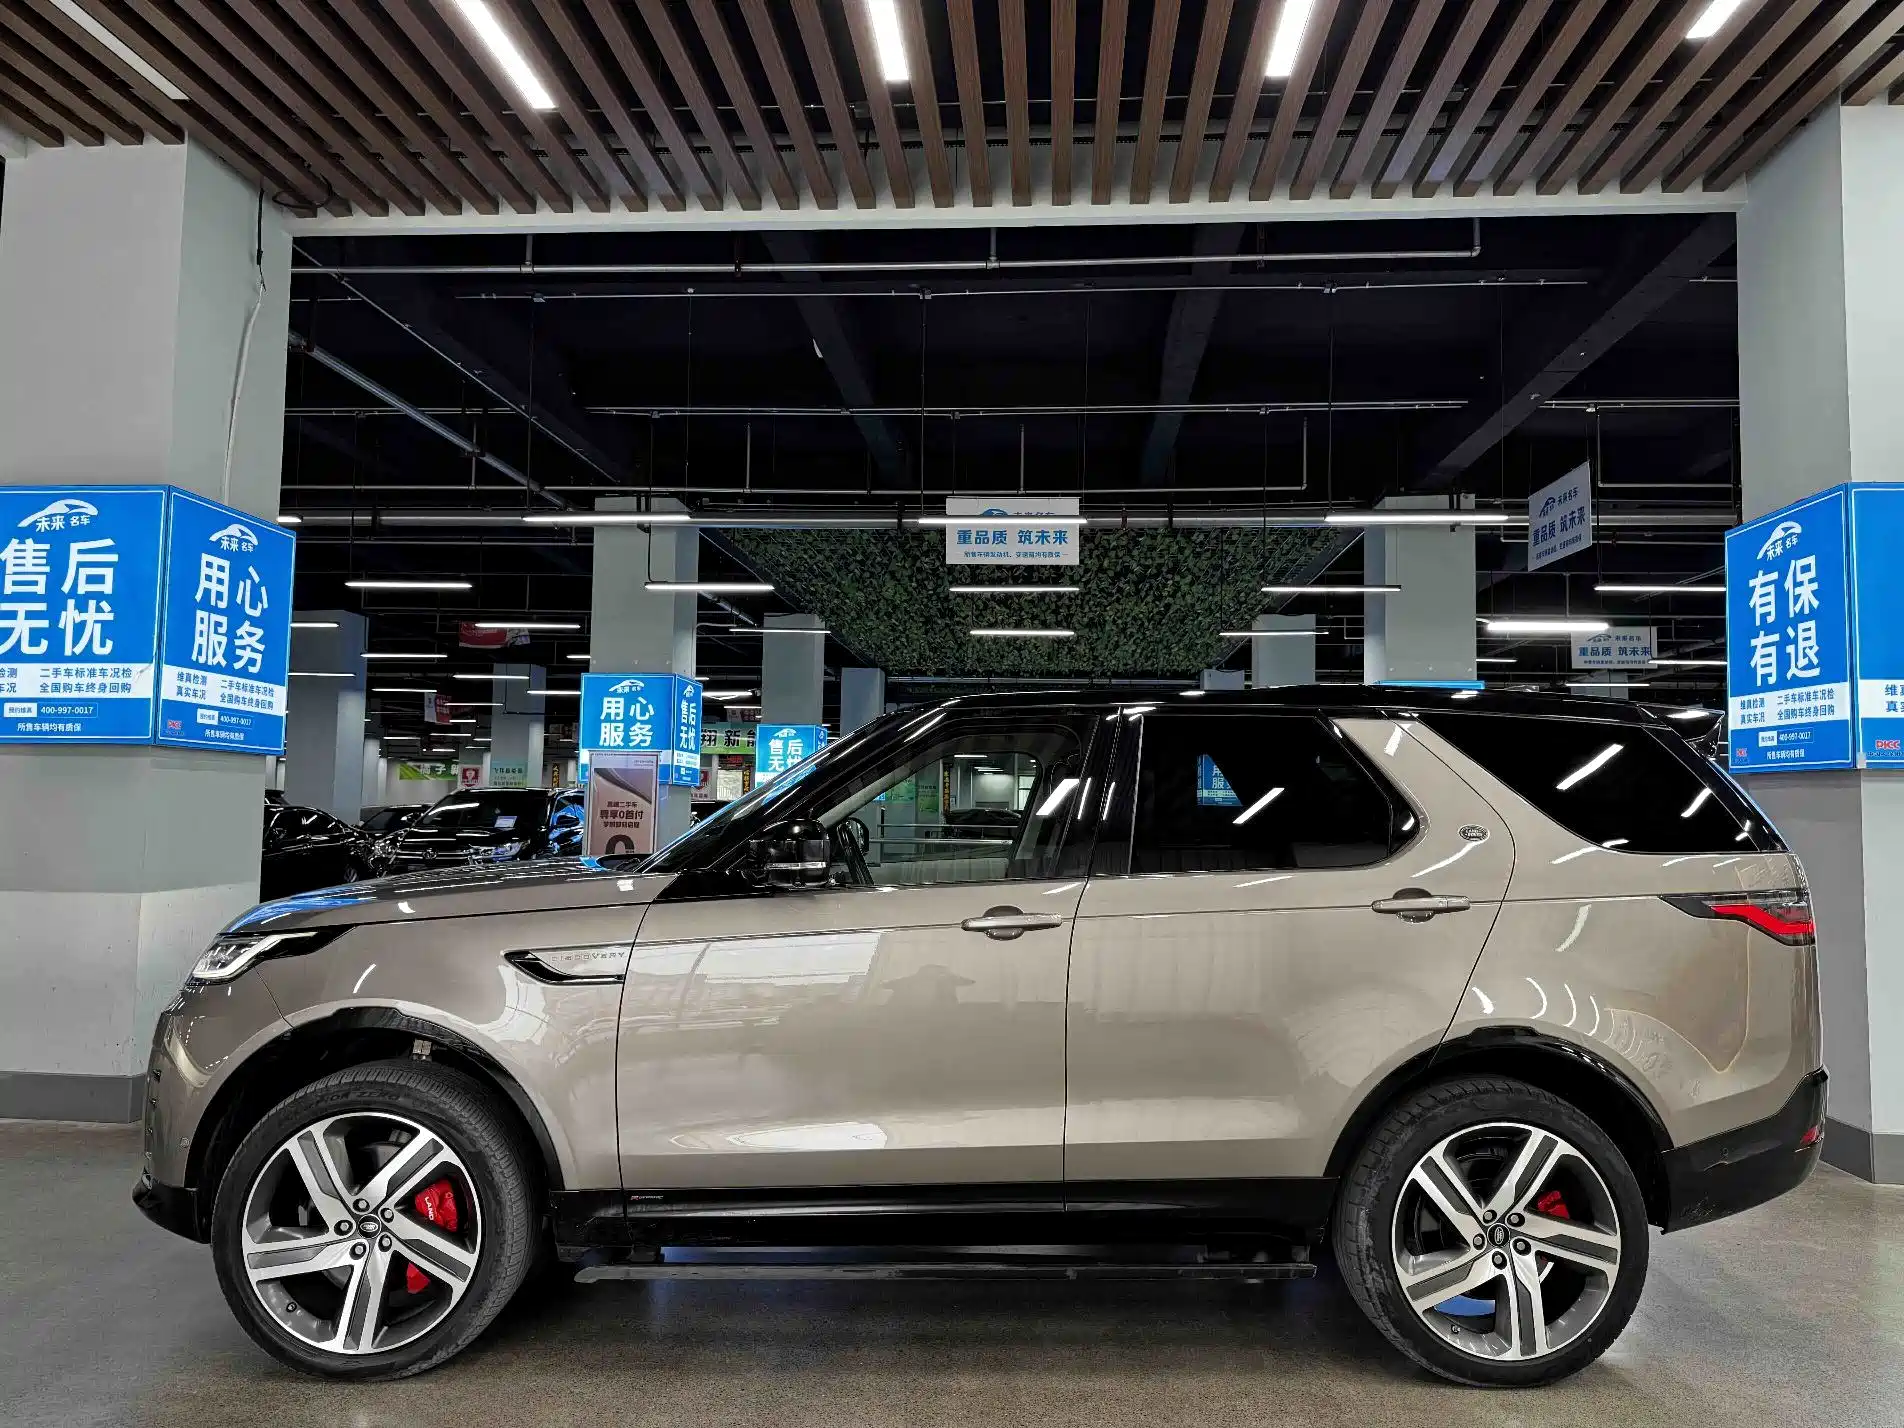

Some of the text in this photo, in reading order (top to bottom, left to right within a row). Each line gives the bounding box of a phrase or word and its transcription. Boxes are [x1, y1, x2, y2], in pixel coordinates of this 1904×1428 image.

[956, 529, 1068, 545] 重品质 筑未来
[1533, 520, 1556, 547] 重品质
[1560, 506, 1586, 533] 筑未来
[0, 538, 119, 595] 售后
[195, 552, 268, 618] 用心
[1749, 554, 1820, 627] 有保
[0, 599, 115, 656] 无忧
[191, 609, 265, 674] 服务
[1579, 646, 1651, 657] 重品质 筑未来
[1750, 619, 1821, 687] 有退
[40, 667, 132, 679] 二手车标准车况检
[39, 682, 132, 693] 全国购车终身回购
[176, 685, 274, 710] 真实车况 全国购车终身回购
[220, 679, 275, 697] 二手车标准车况检
[1777, 688, 1835, 706] 二手车标准车况检
[41, 706, 94, 714] 400-997-0017
[600, 697, 655, 721] 用心
[681, 700, 697, 726] 售后
[1740, 704, 1835, 725] 真实车况 全国购车终身回购
[17, 722, 82, 732] 所售车辆均有质保
[599, 722, 654, 747] 服务
[768, 738, 803, 755] 售后
[424, 1196, 435, 1221] LAND
